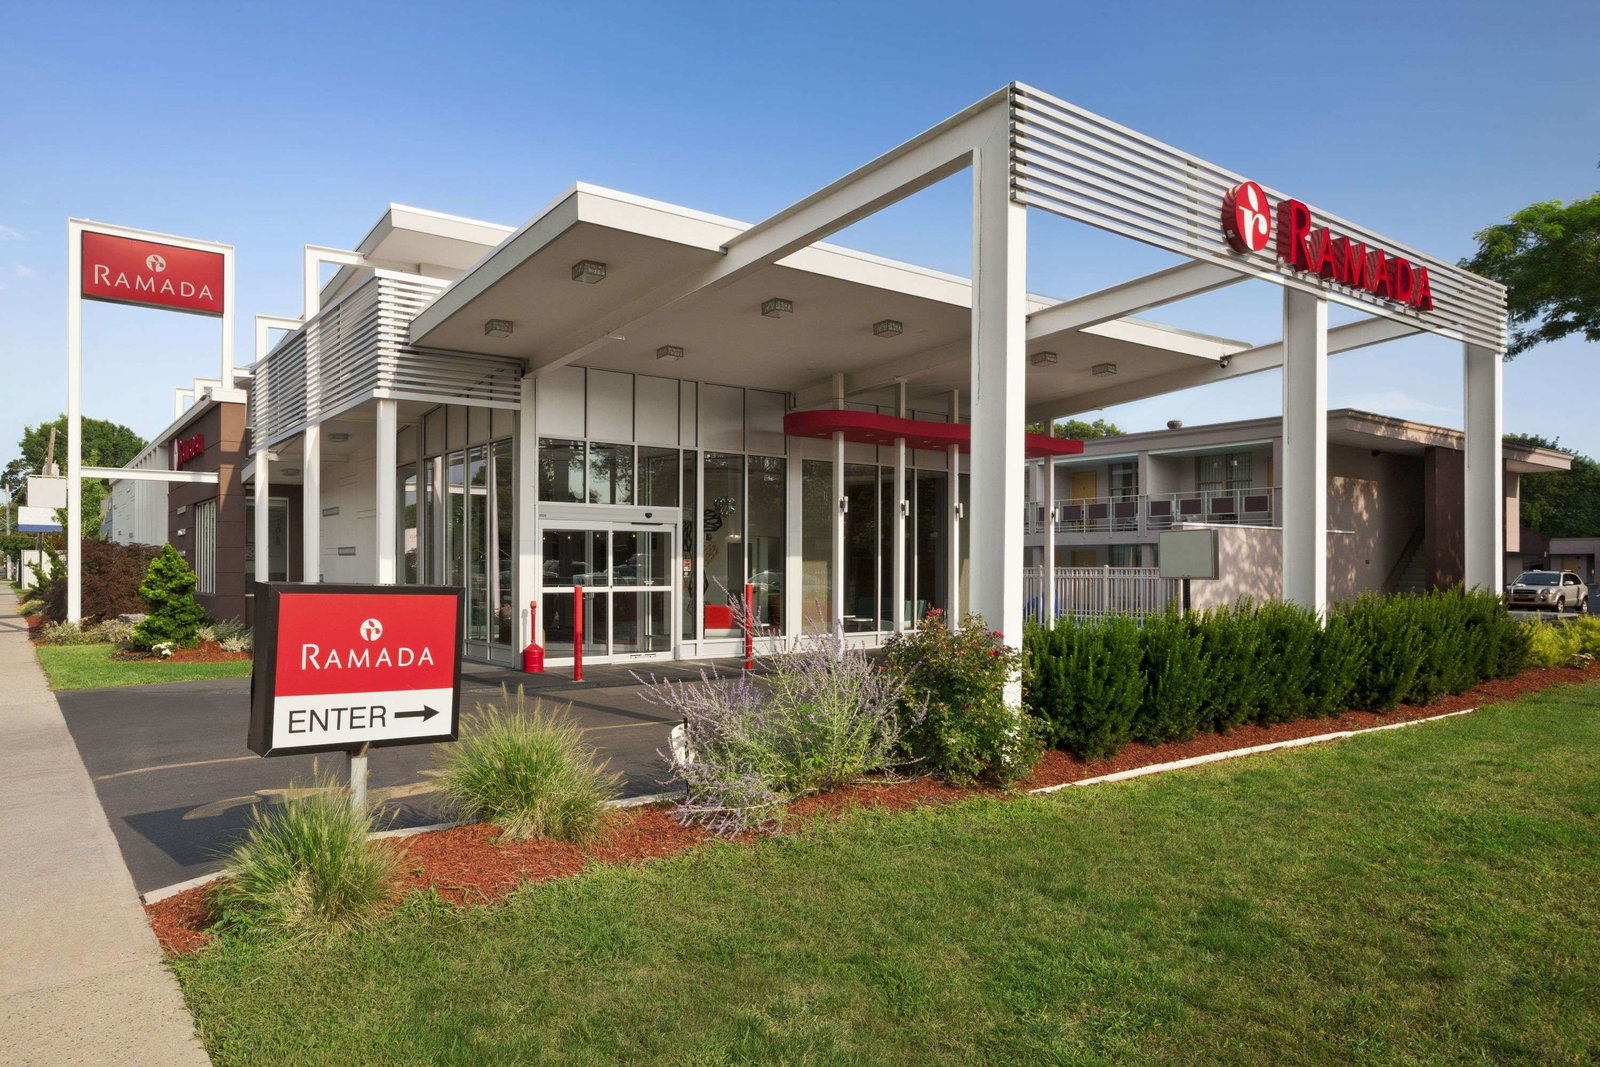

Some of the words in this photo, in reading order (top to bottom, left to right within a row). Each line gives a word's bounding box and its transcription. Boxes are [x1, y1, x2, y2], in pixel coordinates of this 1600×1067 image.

[1277, 199, 1434, 311] RAMADA
[94, 264, 213, 301] RAMADA
[301, 643, 434, 670] RAMADA
[288, 705, 387, 734] ENTER
